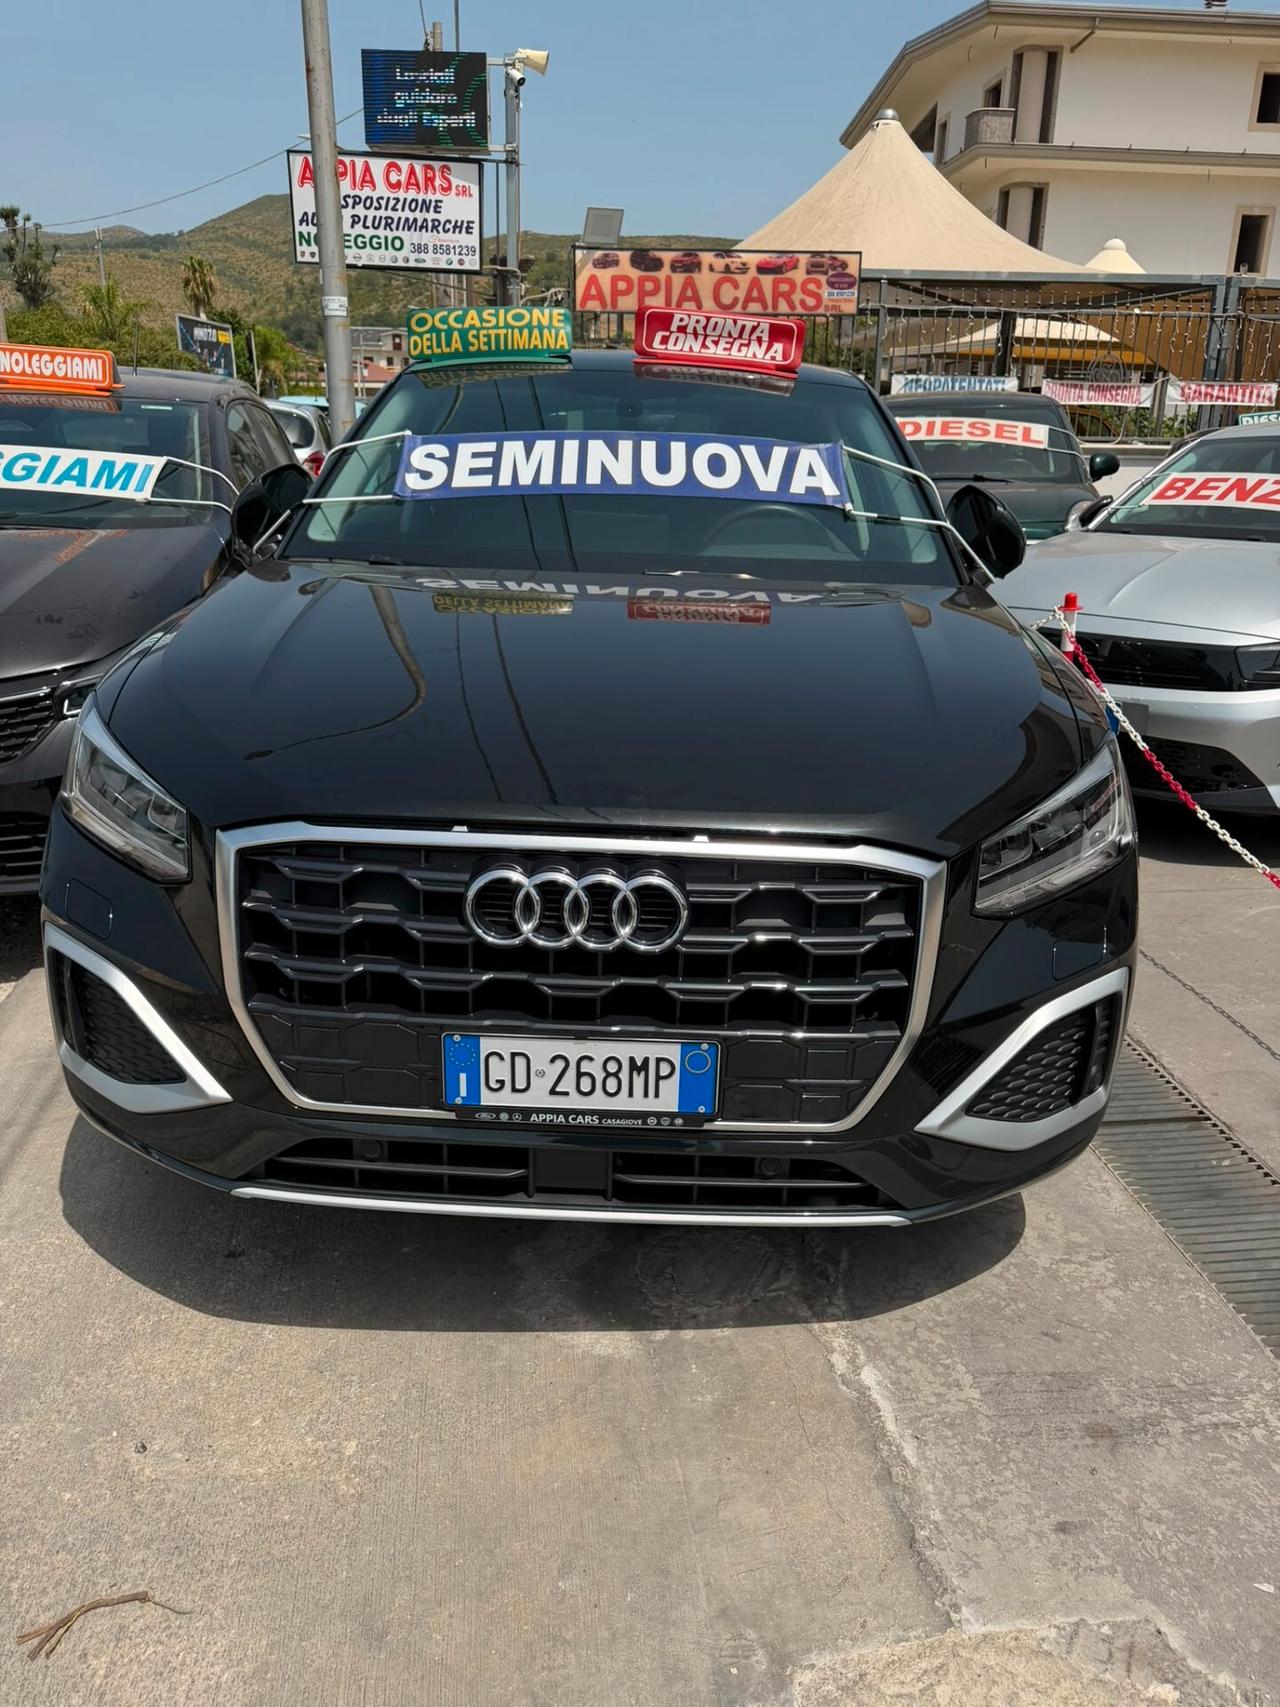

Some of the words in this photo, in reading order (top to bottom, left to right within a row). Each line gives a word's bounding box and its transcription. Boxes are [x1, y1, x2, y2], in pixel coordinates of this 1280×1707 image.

[297, 156, 377, 192] APIA
[383, 160, 453, 197] CARS
[455, 184, 473, 198] SRL
[342, 194, 443, 215] SPOSIZIONE
[350, 214, 475, 236] PLURIMARCHE
[298, 231, 405, 252] NEGGIO
[410, 243, 428, 255] 388
[432, 244, 477, 257] 8581239
[579, 274, 703, 311] APPIA
[712, 275, 824, 313] CARS
[824, 304, 844, 313] SRL
[410, 308, 566, 333] OCCASIONE
[669, 312, 771, 341] PRONTA
[410, 329, 464, 356] DELLA
[468, 328, 569, 352] SETTIMANA
[652, 329, 785, 362] CONSEGNA
[0, 350, 103, 381] NOLEGGIAMI
[1045, 382, 1084, 402] PRONTA
[1086, 383, 1142, 404] CONSEGNA
[1179, 383, 1273, 404] GARANTITA
[897, 420, 1044, 445] DIESEL
[0, 450, 155, 493] GIAMI
[404, 438, 841, 497] SEMINUOVA
[1150, 477, 1280, 505] BENZ
[484, 1050, 531, 1093] GD
[549, 1054, 676, 1099] 268MP
[530, 1113, 566, 1124] APPIA
[568, 1114, 600, 1125] CARS
[602, 1118, 643, 1126] CASAGIOVE
